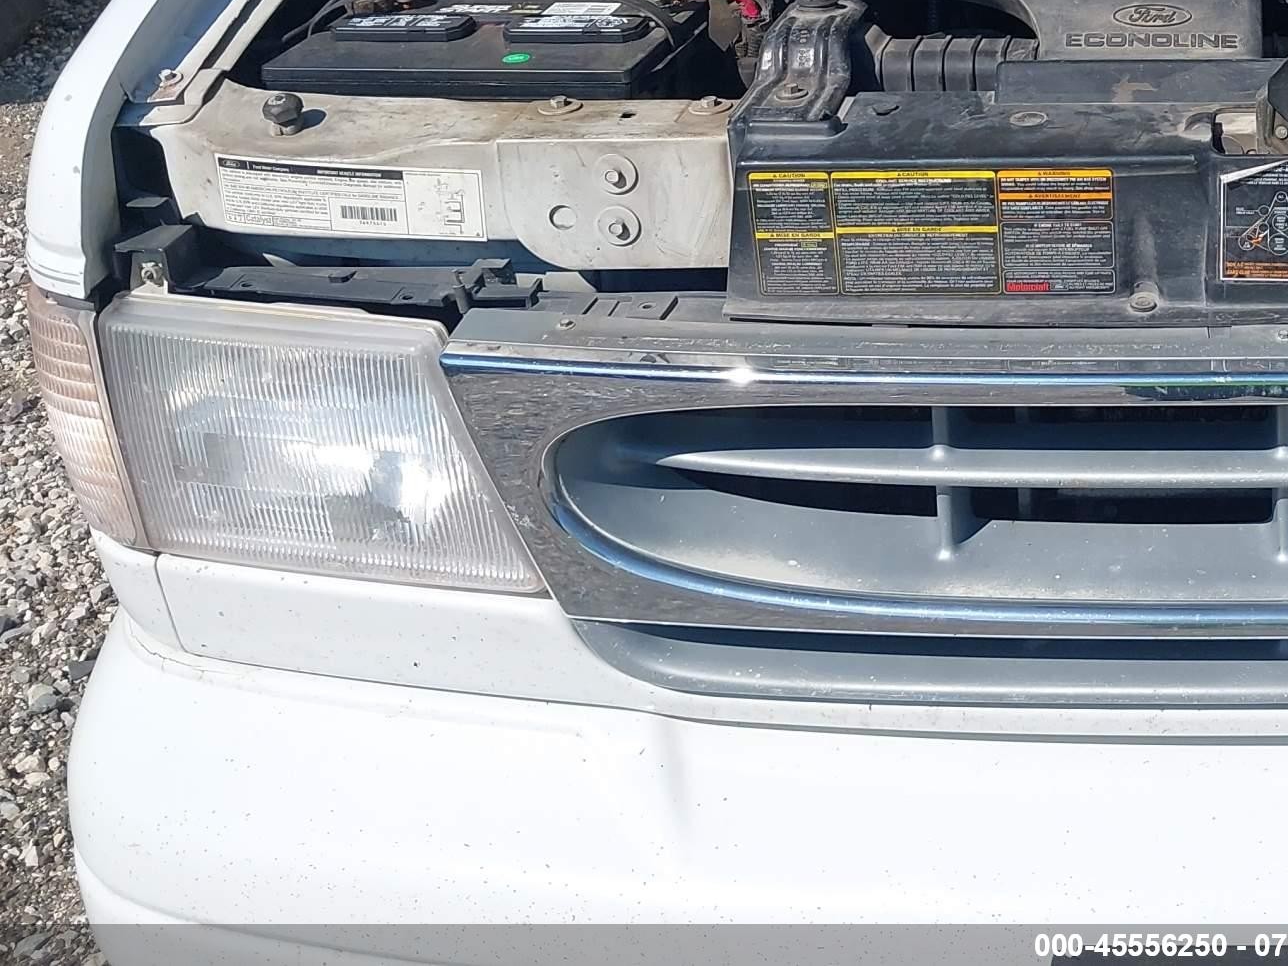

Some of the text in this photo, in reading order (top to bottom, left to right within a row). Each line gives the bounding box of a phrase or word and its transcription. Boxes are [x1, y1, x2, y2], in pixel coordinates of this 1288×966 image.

[1128, 6, 1176, 23] Ford
[1065, 32, 1239, 49] ECONOLINE
[1007, 282, 1050, 291] Motorcraft
